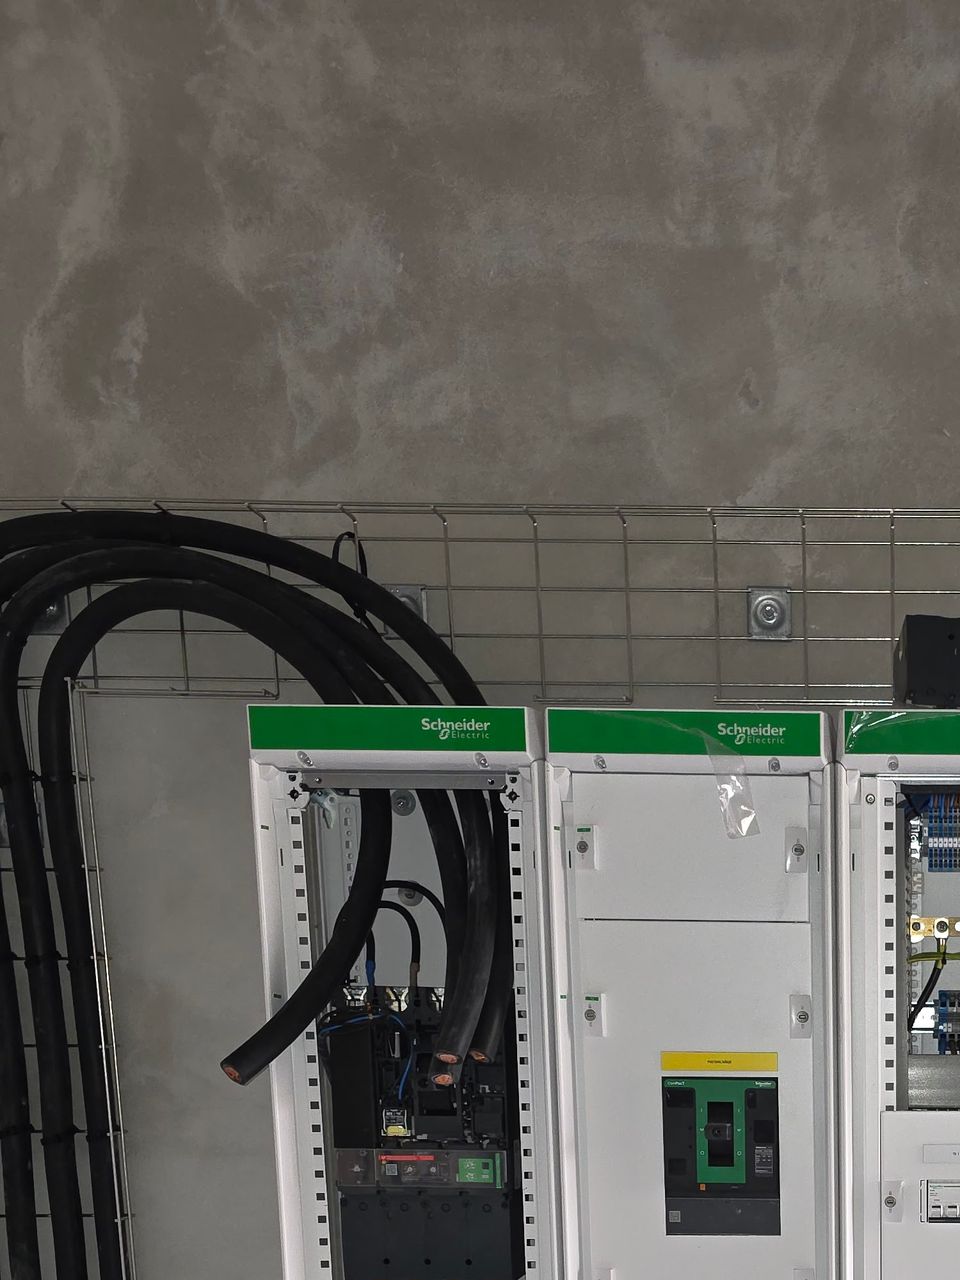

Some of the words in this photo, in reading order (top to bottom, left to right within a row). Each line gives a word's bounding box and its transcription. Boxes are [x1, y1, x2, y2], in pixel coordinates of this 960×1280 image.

[421, 718, 490, 731] Schneider
[717, 722, 786, 736] Schneider
[451, 731, 490, 739] Electric
[747, 736, 785, 744] Electric
